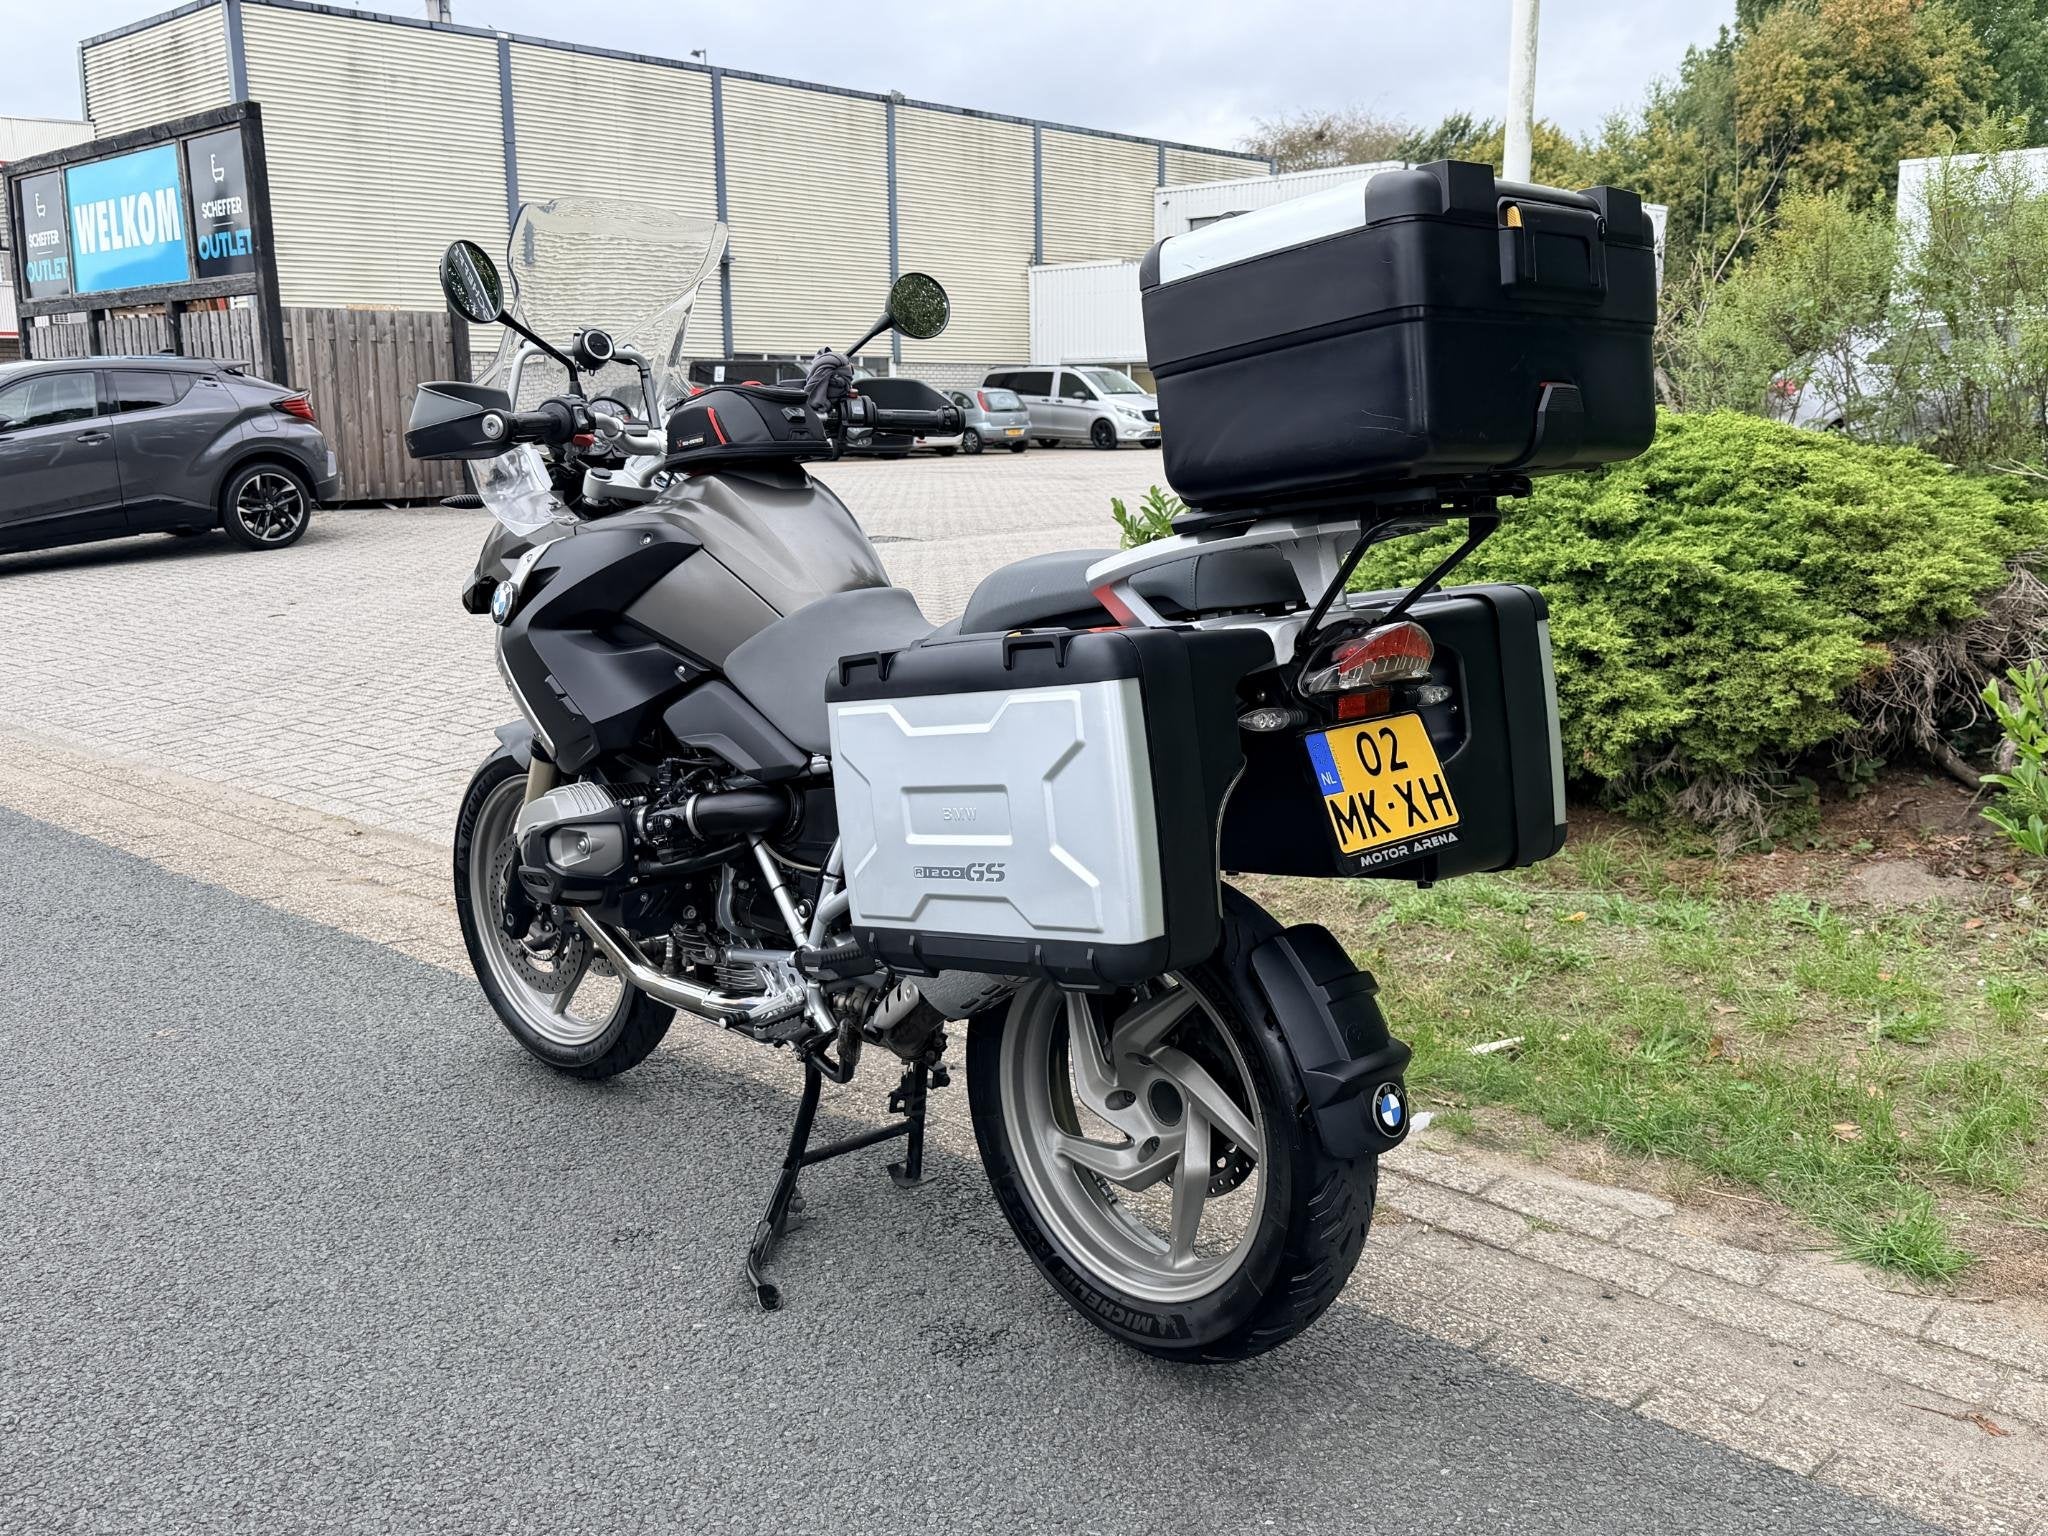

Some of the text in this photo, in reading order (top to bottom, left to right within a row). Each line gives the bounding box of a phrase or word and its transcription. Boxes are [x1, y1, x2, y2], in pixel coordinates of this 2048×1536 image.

[74, 187, 182, 255] WELKOM
[201, 196, 243, 219] SCHEFFER
[28, 229, 60, 248] SCHEFFER
[198, 228, 253, 260] OUTLET
[26, 256, 68, 283] OUTLET
[1356, 727, 1409, 776] 02
[1320, 771, 1337, 786] NL
[942, 807, 977, 822] BMW
[1360, 831, 1459, 867] MOTOR ARENA
[1377, 1085, 1401, 1106] BMW
[1056, 1266, 1154, 1334] MICHELIN
